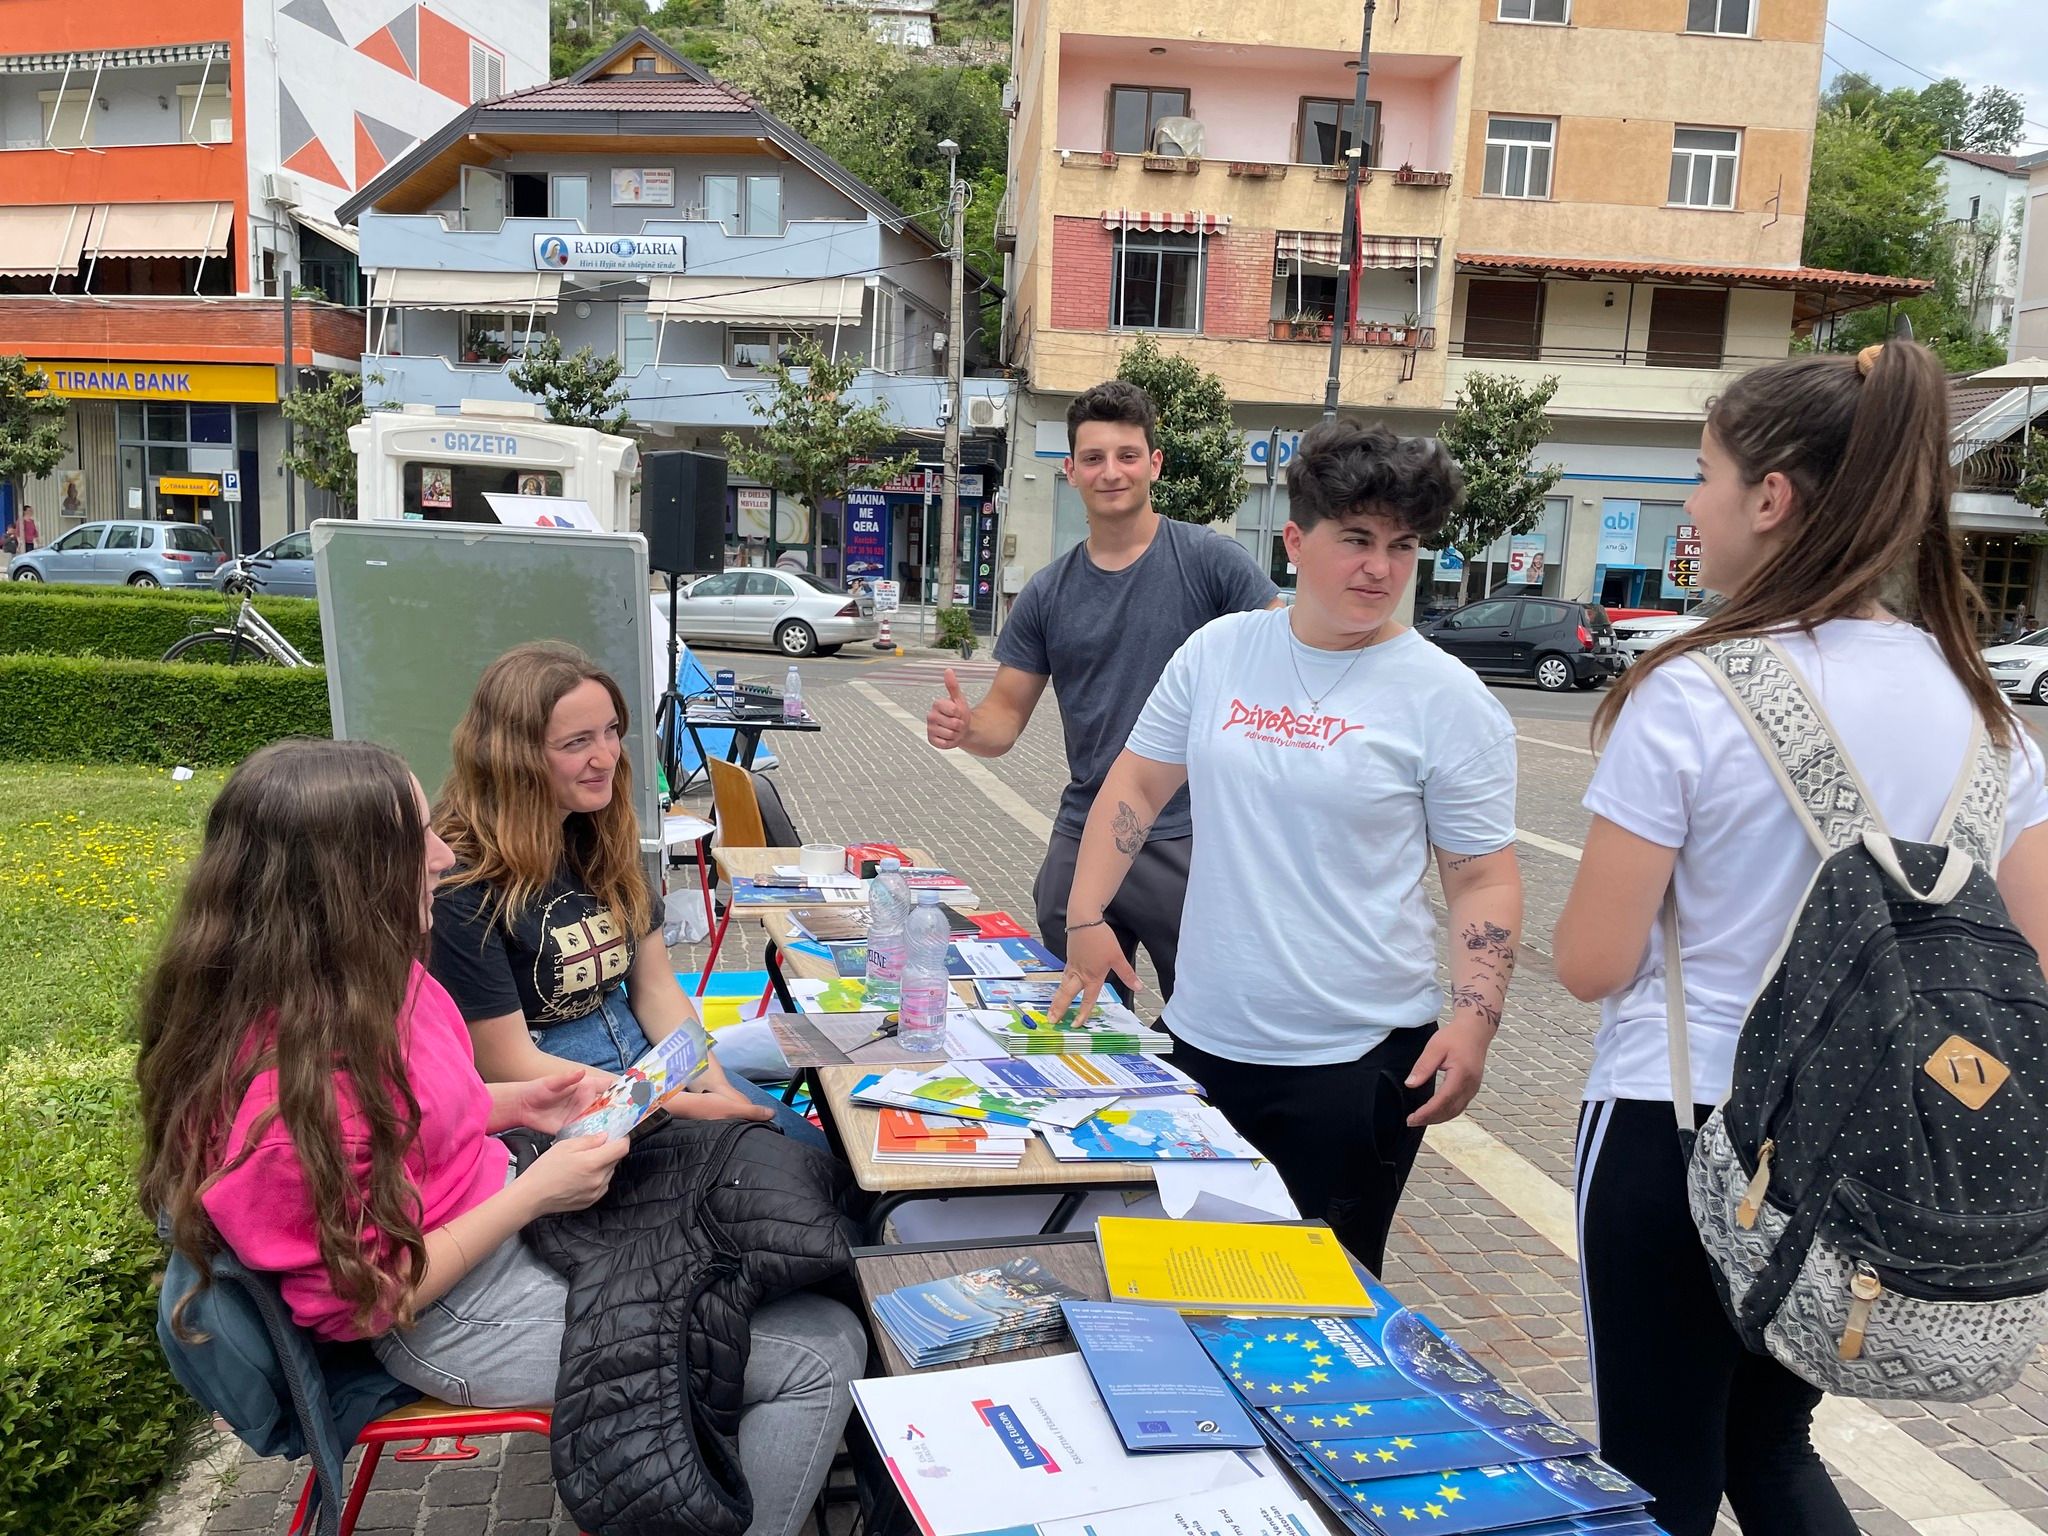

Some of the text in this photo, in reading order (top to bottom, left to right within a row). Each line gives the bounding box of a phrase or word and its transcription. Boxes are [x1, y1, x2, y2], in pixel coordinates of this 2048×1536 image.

[575, 242, 677, 255] RADIO MARIA
[55, 371, 192, 392] TIRANA BANK
[444, 432, 516, 455] GAZETA
[228, 475, 235, 487] P
[848, 494, 886, 505] MAKINA
[859, 508, 874, 518] ME
[1604, 512, 1635, 530] abi
[853, 521, 879, 532] QERA
[998, 1411, 1020, 1438] EUROPA
[1014, 1436, 1025, 1445] &
[1174, 1513, 1189, 1530] with
[1218, 1509, 1233, 1524] End
[1260, 1507, 1282, 1536] Veneta-
[1270, 1506, 1297, 1536] Historian
[1192, 1520, 1206, 1536] onia
